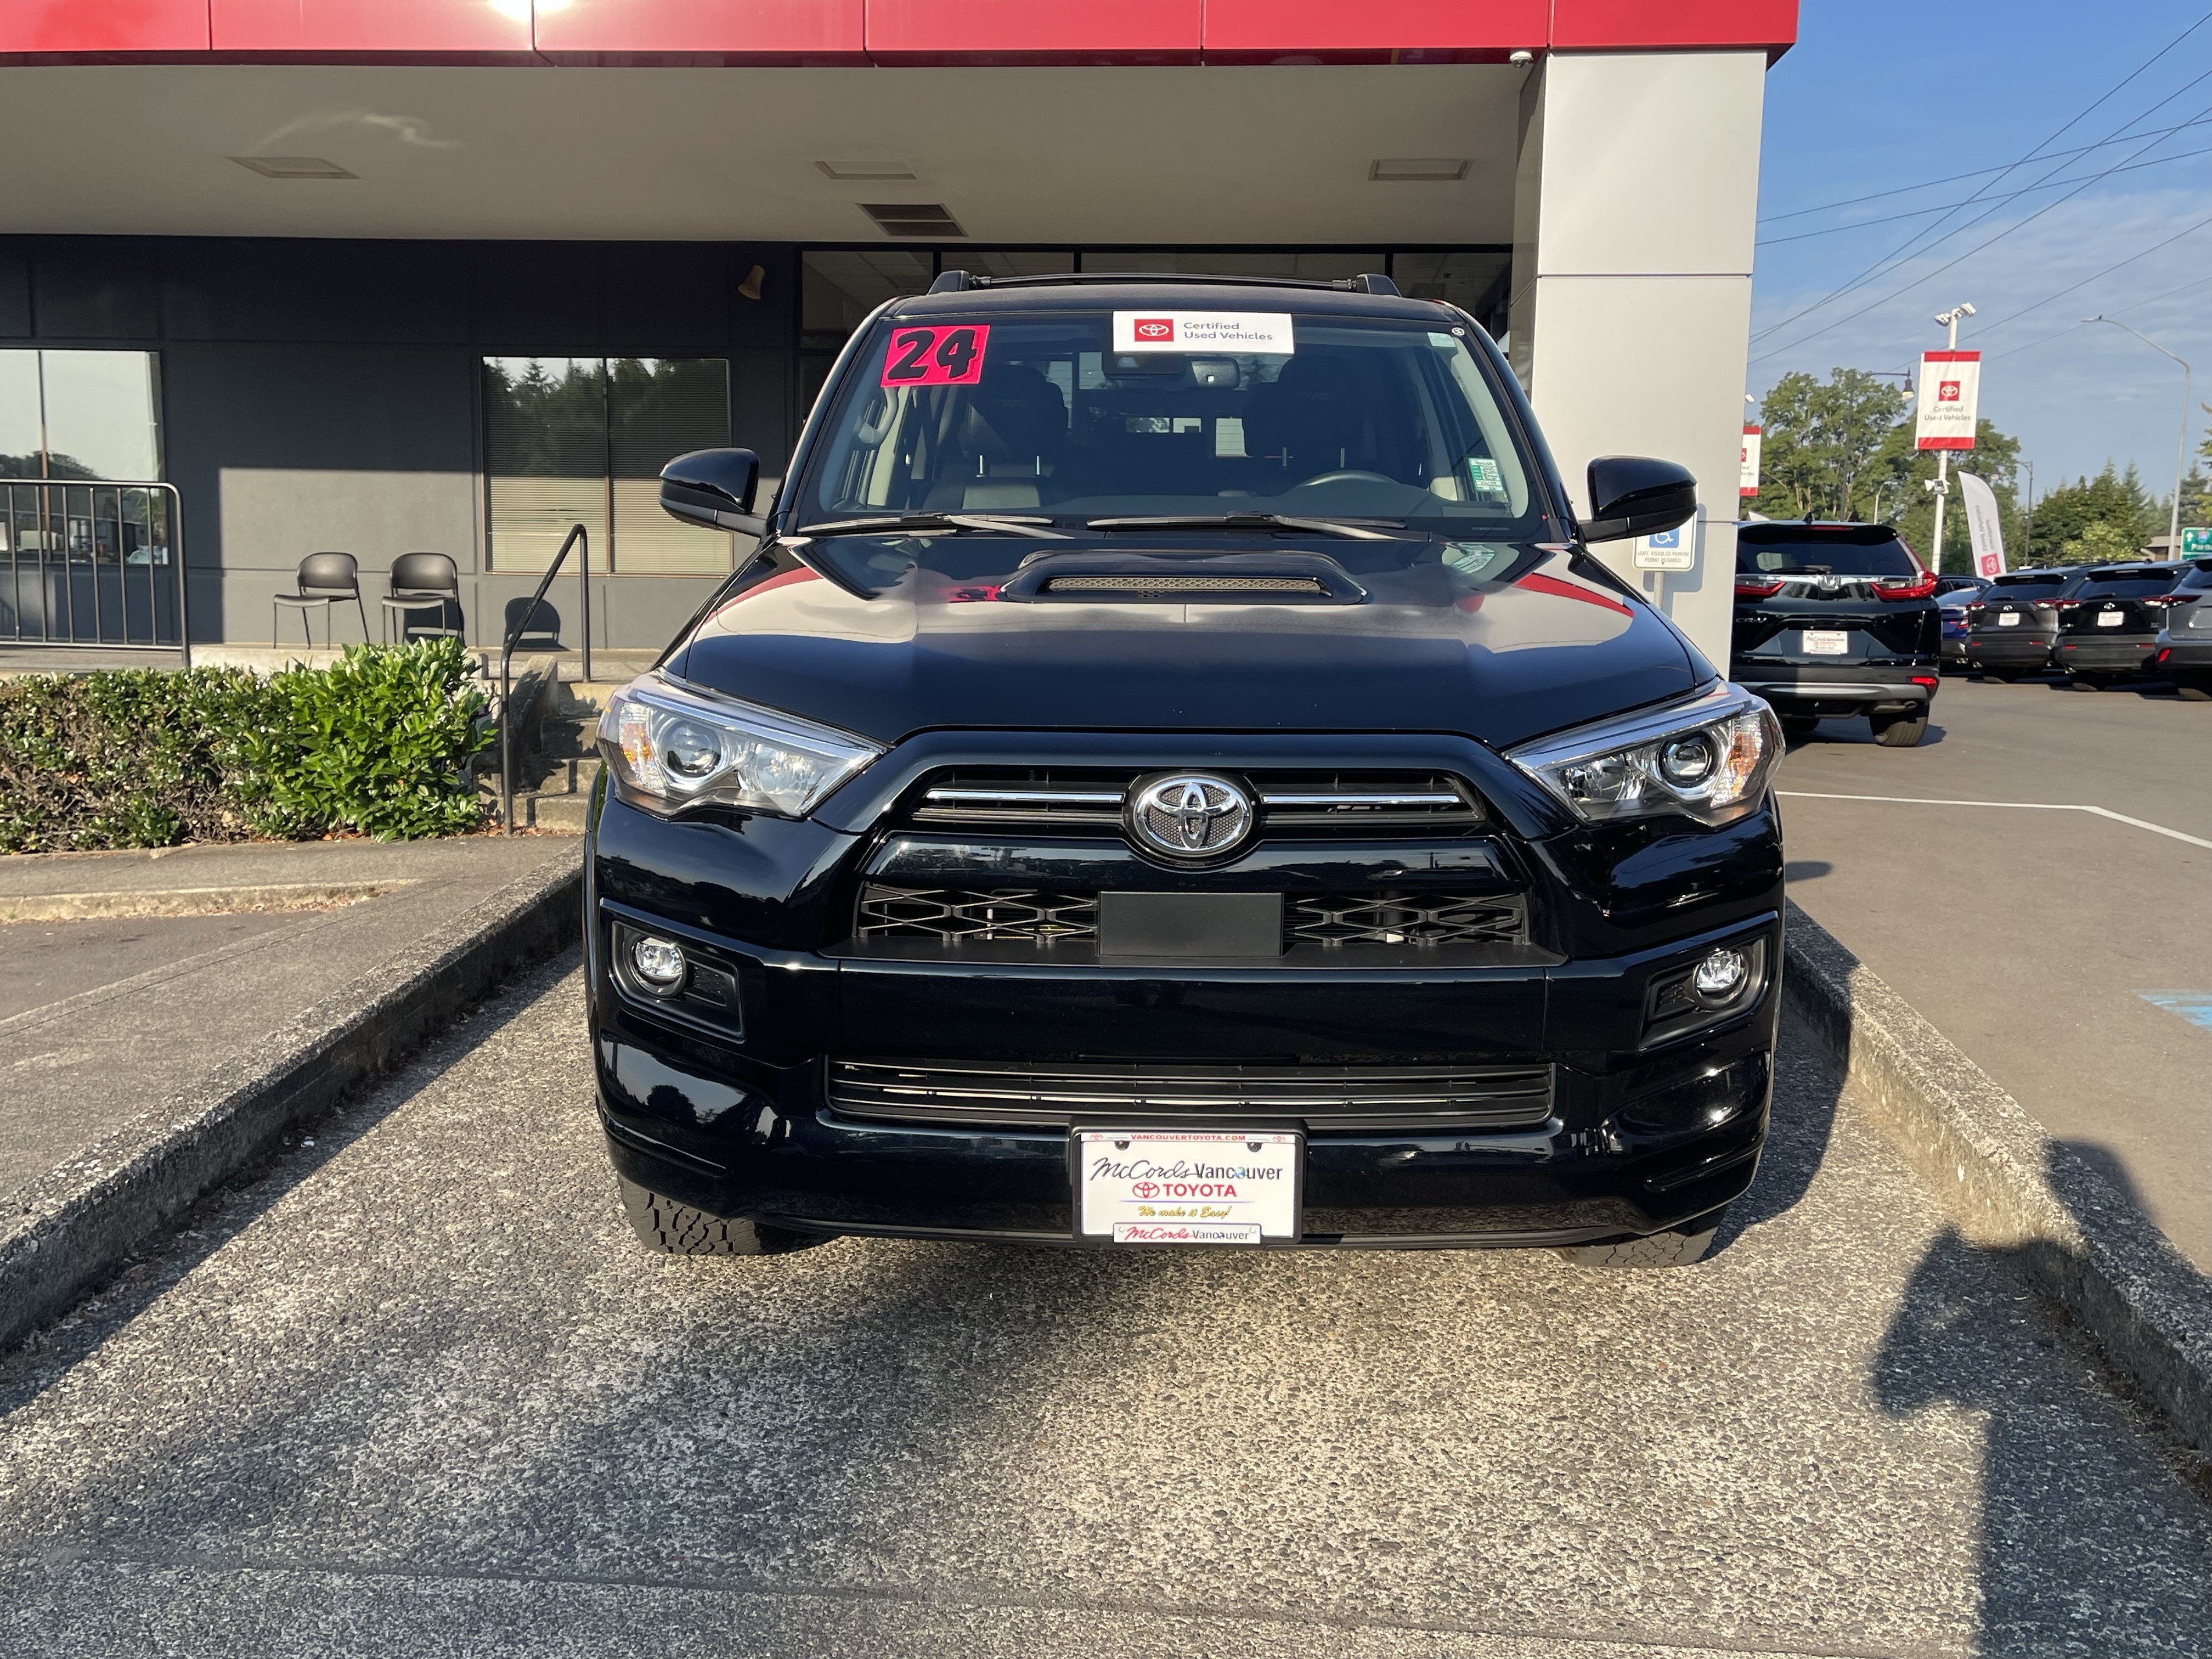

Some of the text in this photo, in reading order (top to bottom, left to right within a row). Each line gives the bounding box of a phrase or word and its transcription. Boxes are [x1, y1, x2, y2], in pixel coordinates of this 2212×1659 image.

[1183, 321, 1239, 330] Certified
[1220, 331, 1273, 340] Vehicles
[887, 329, 977, 380] 24
[1163, 1184, 1237, 1197] TOYOTA
[1138, 1205, 1232, 1220] We make it Easy!
